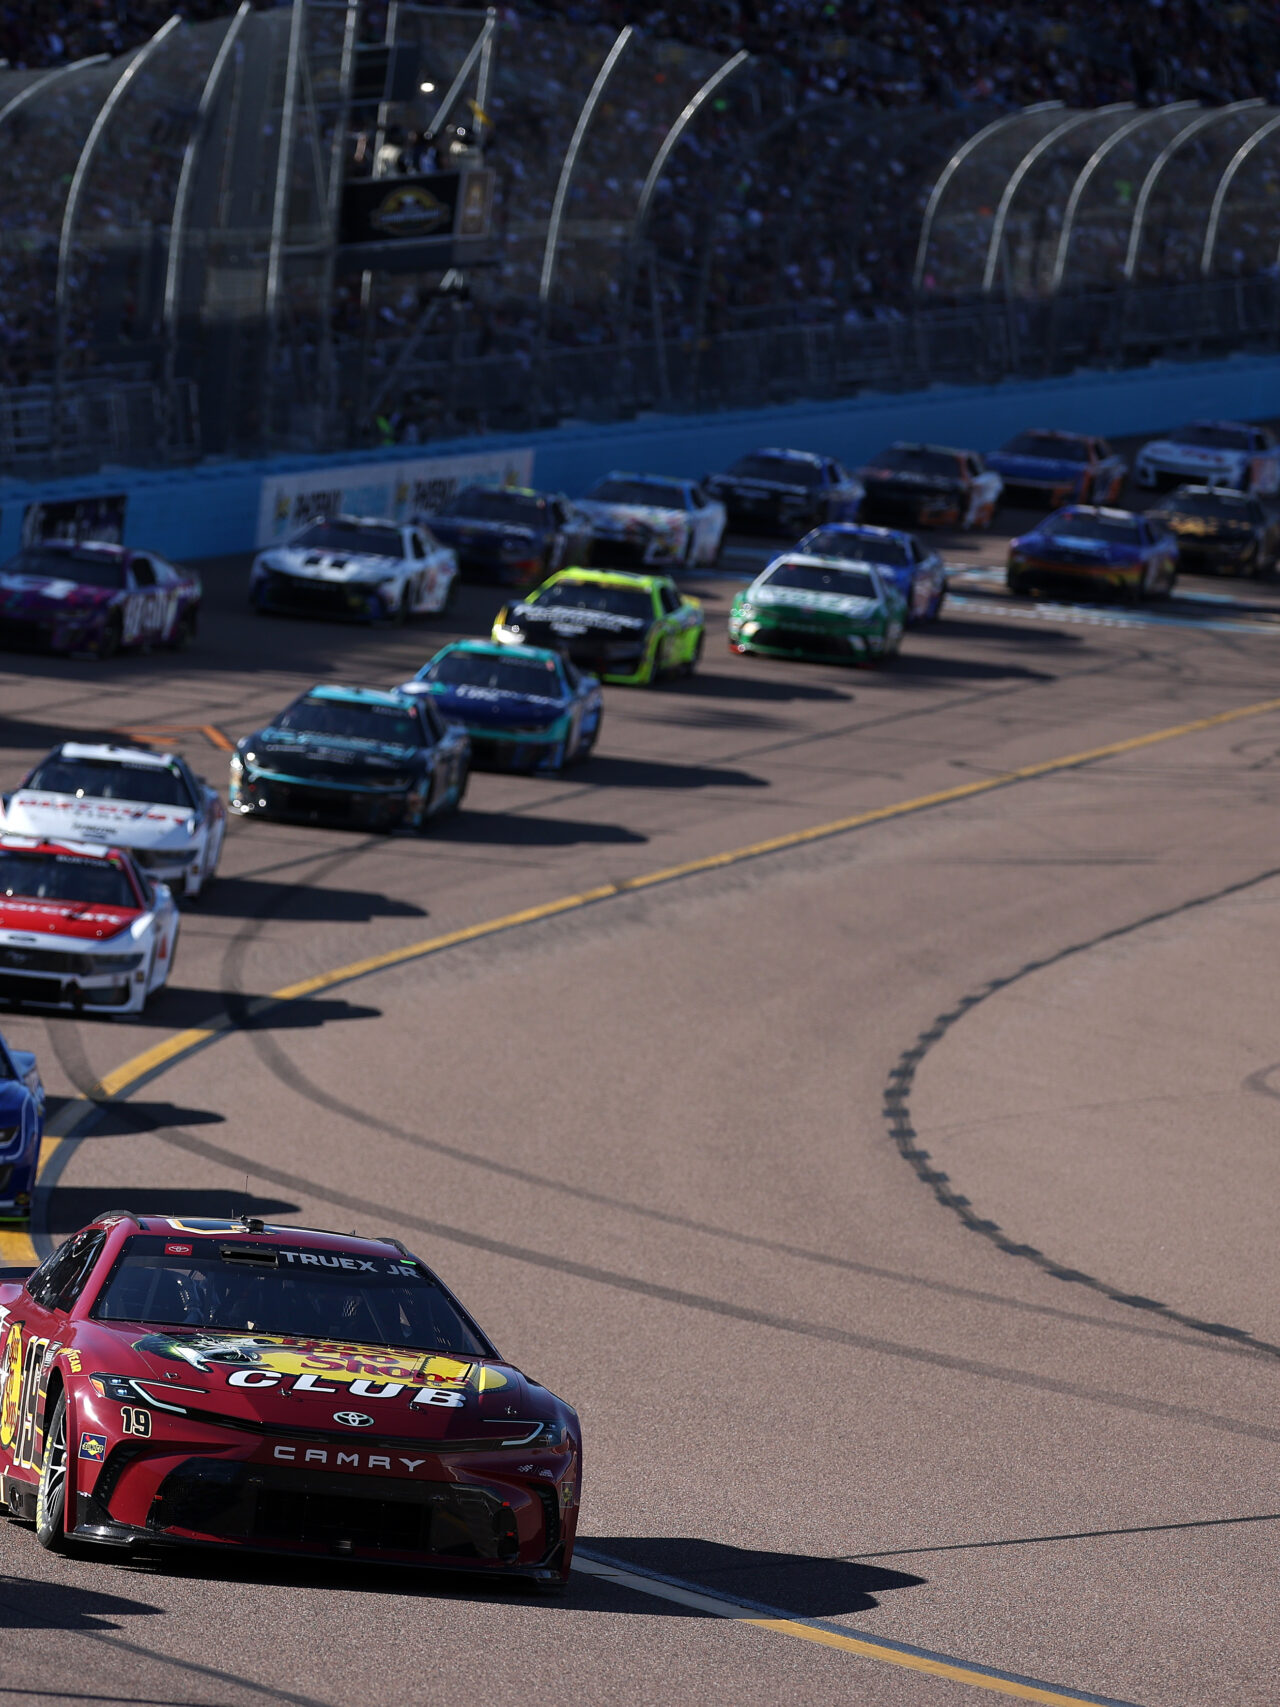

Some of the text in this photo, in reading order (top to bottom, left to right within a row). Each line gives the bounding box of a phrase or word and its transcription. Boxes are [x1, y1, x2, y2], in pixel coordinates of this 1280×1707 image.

[279, 1251, 420, 1279] TRUEX JR
[13, 1335, 50, 1469] 19
[228, 1369, 467, 1408] CLUB
[120, 1406, 152, 1438] 19
[82, 1442, 105, 1454] SUNOCO
[274, 1446, 427, 1472] CAMRY
